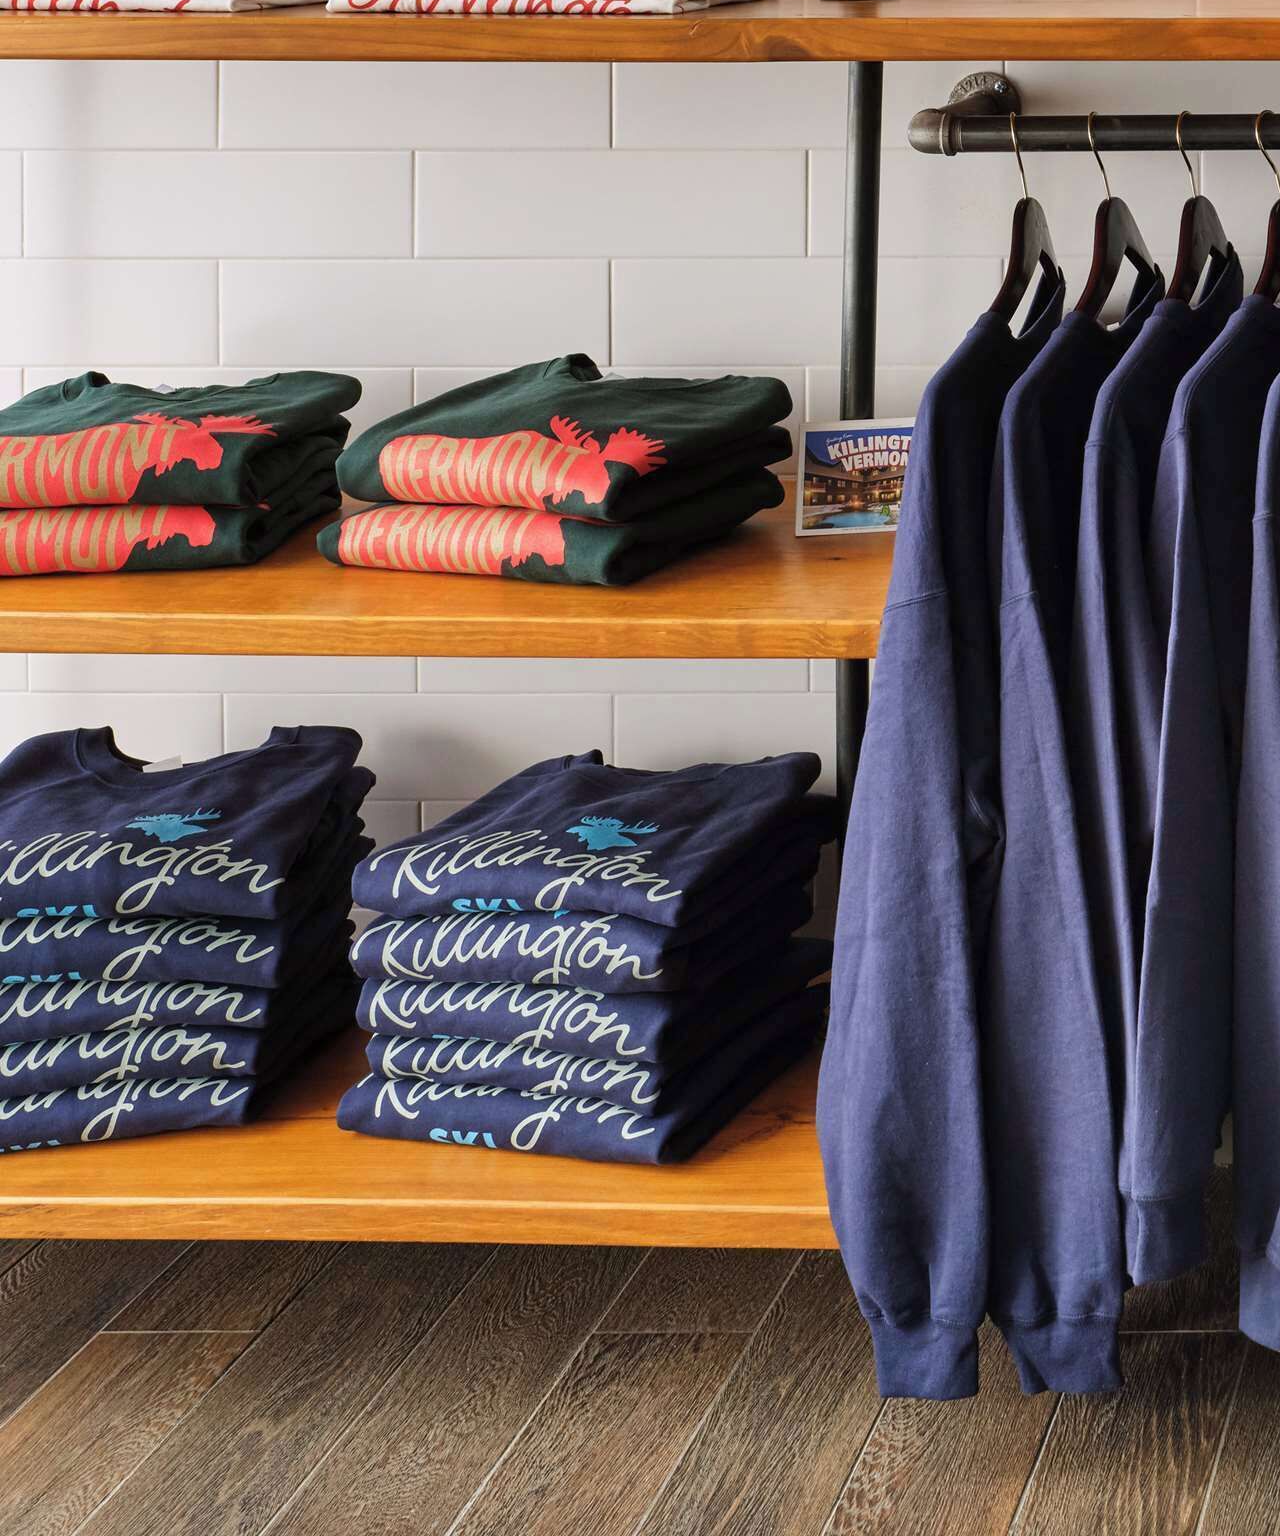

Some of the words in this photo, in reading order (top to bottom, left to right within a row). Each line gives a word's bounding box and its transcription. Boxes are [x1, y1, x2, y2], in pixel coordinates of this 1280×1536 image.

[381, 431, 591, 510] VERMONT
[369, 829, 683, 912] Killington
[352, 913, 663, 985] Killington
